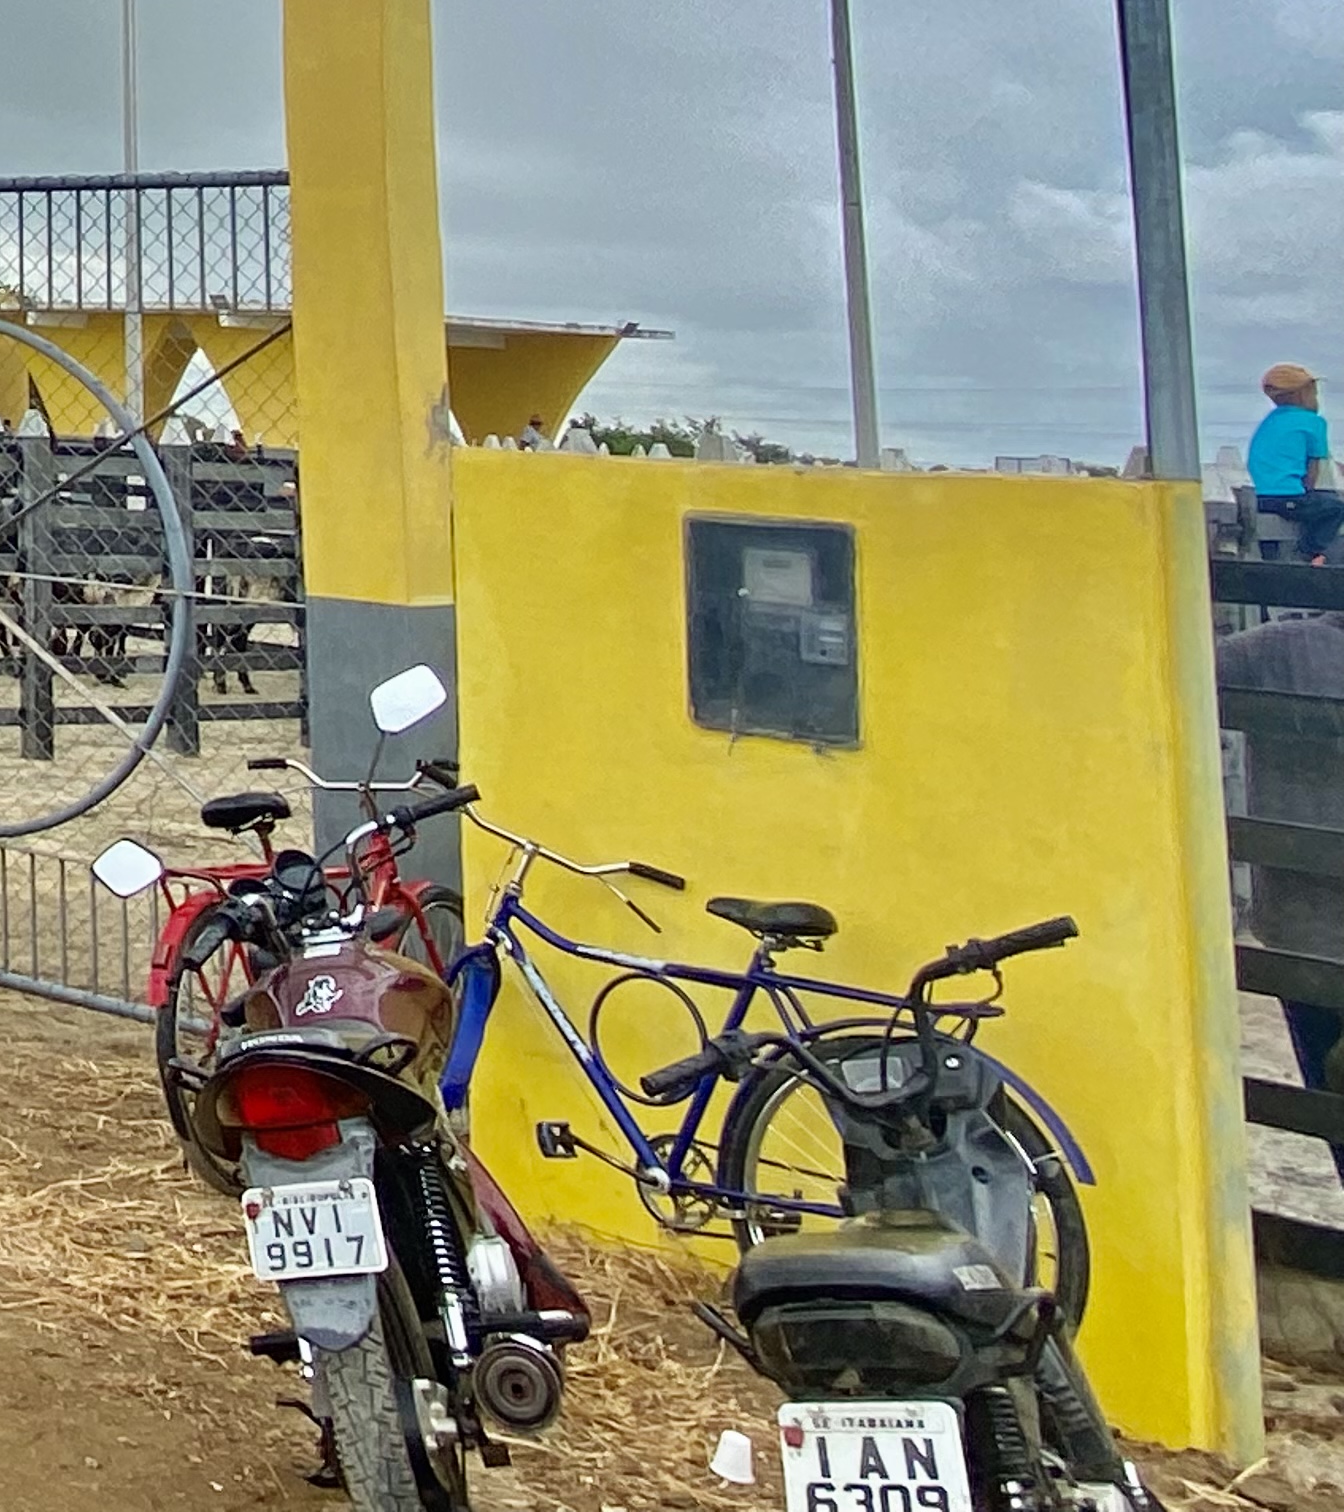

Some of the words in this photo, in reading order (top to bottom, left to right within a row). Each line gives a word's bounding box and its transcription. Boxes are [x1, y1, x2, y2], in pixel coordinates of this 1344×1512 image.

[272, 1204, 343, 1238] NVI
[266, 1234, 365, 1271] 9917
[816, 1436, 940, 1480] IAN
[806, 1482, 951, 1512] 6309
